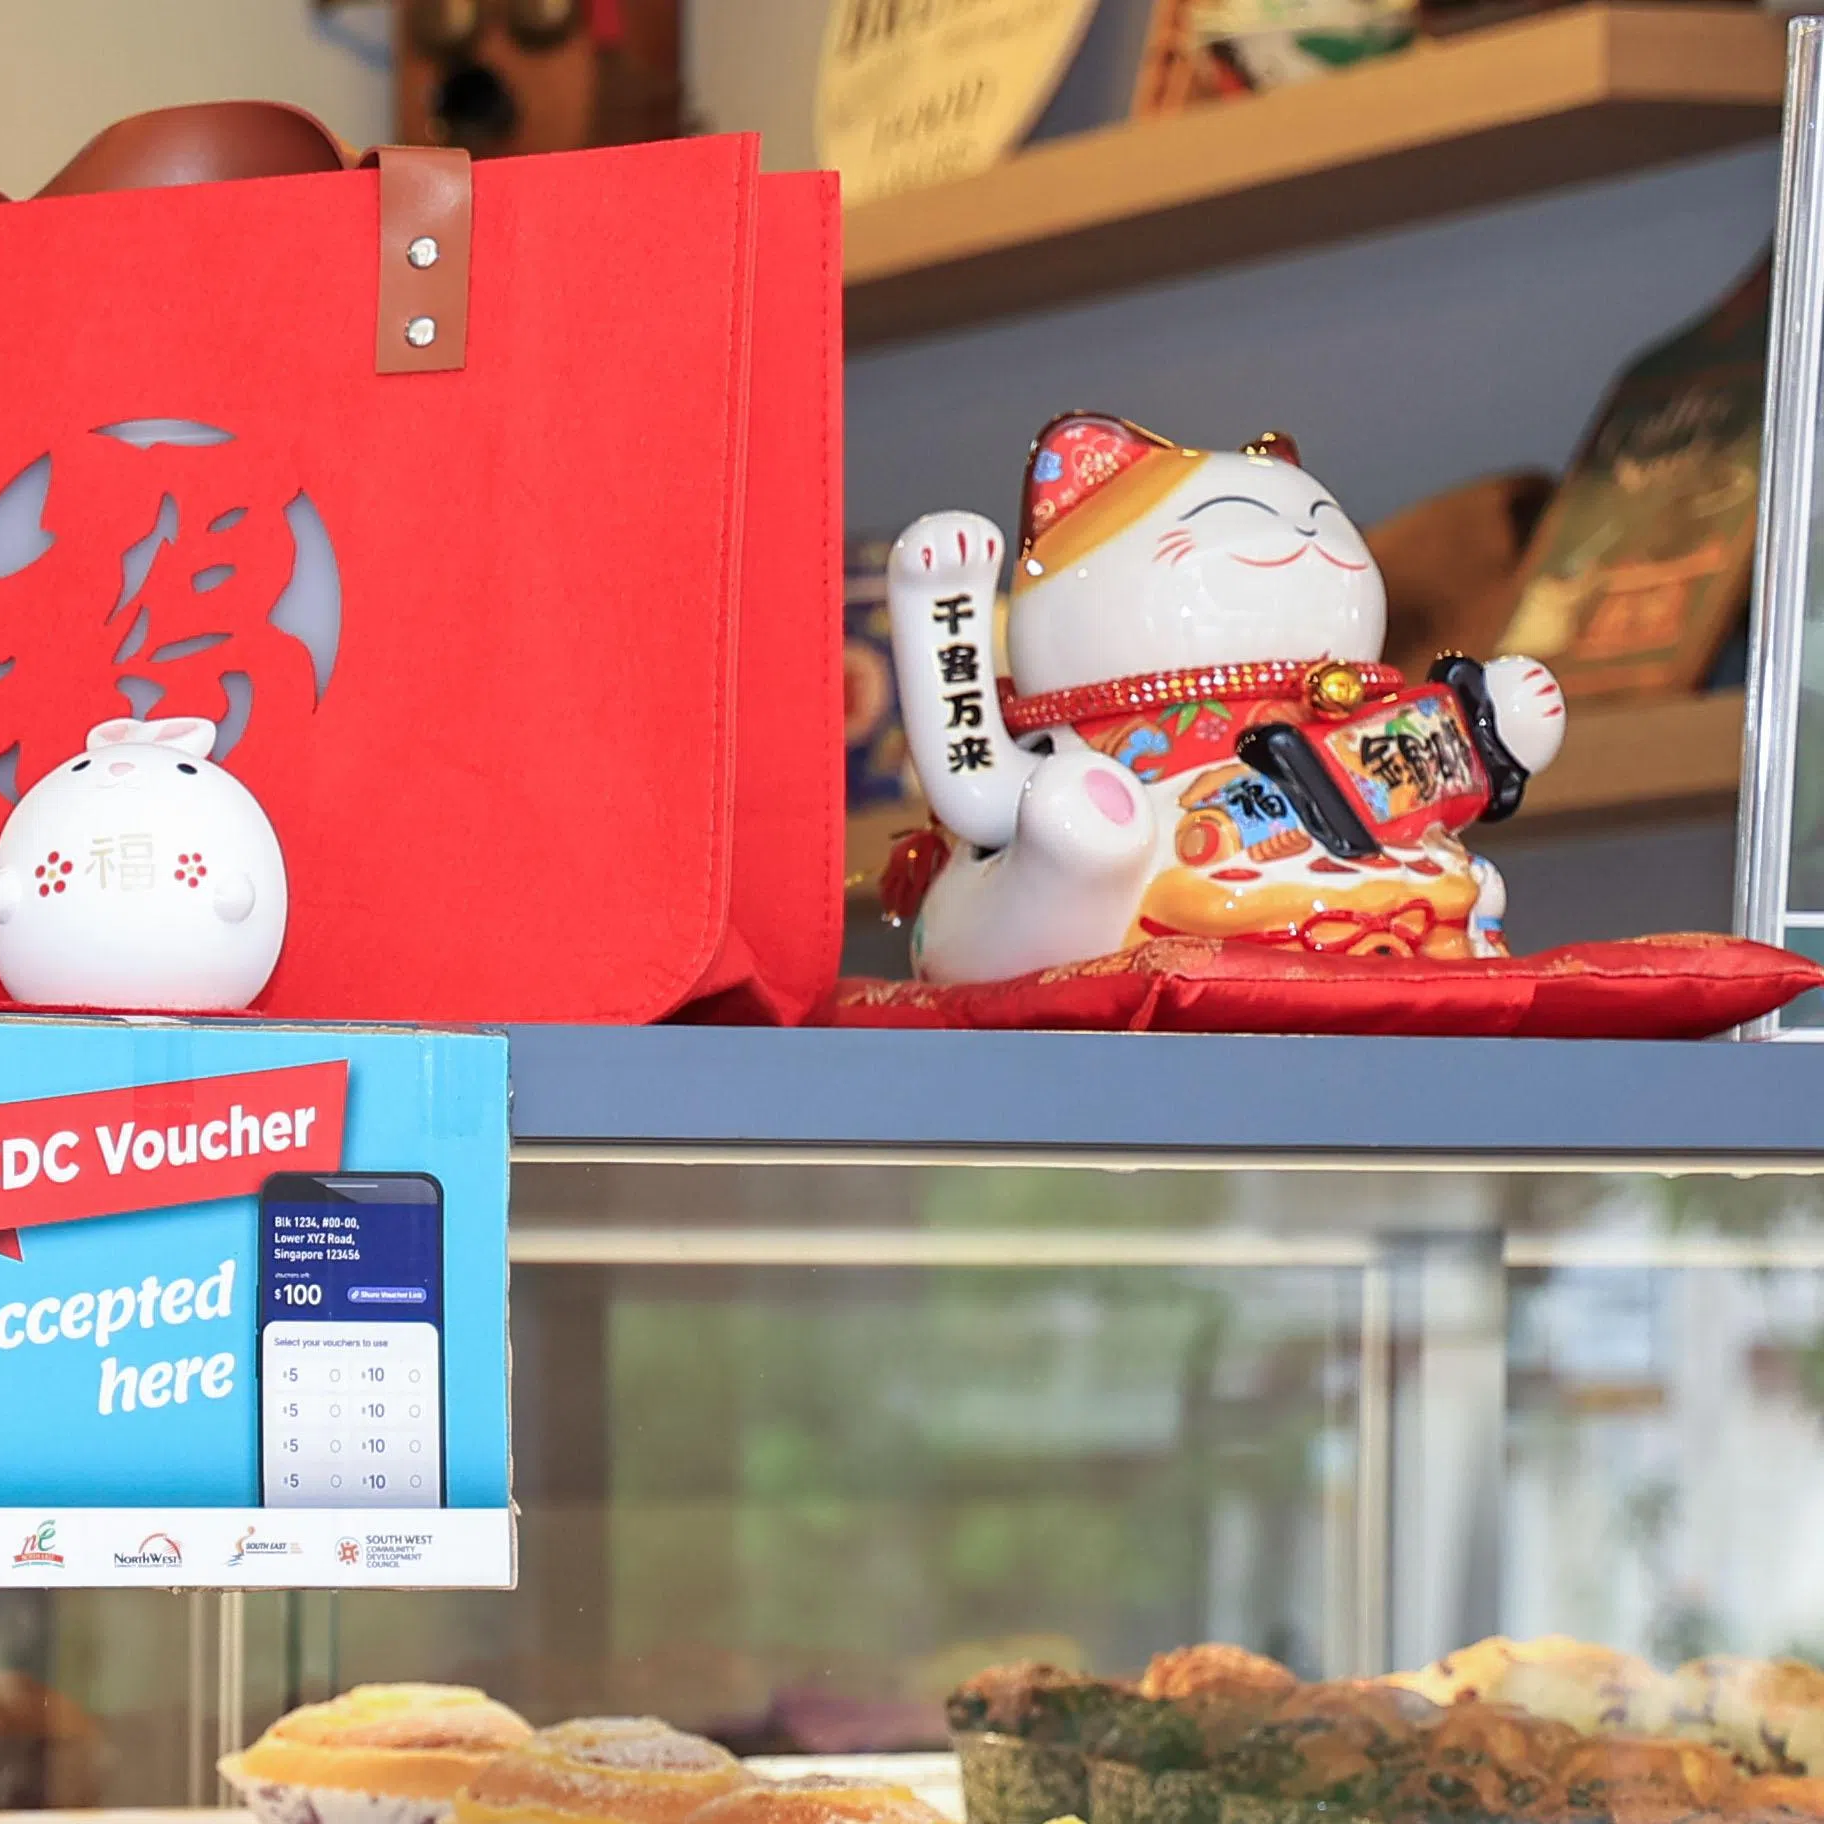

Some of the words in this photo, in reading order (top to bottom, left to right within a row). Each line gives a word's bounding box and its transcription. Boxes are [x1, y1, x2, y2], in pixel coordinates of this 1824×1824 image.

[933, 593, 994, 774] 千客万来
[84, 832, 156, 893] 福
[95, 1104, 316, 1176] Voucher
[274, 1216, 292, 1228] Blk
[294, 1216, 320, 1229] 1234,
[322, 1217, 360, 1230] #00-00,
[274, 1233, 305, 1244] Lower
[307, 1233, 325, 1244] XYZ
[327, 1234, 355, 1246] Road,
[274, 1249, 323, 1262] Singapore
[326, 1249, 360, 1260] 123456
[274, 1284, 322, 1306] $100
[274, 1337, 300, 1347] Select
[302, 1339, 320, 1349] your
[322, 1338, 360, 1347] vouchers
[372, 1339, 388, 1347] use
[97, 1351, 236, 1416] here
[366, 1535, 403, 1545] SOUTH
[405, 1535, 433, 1545] WEST
